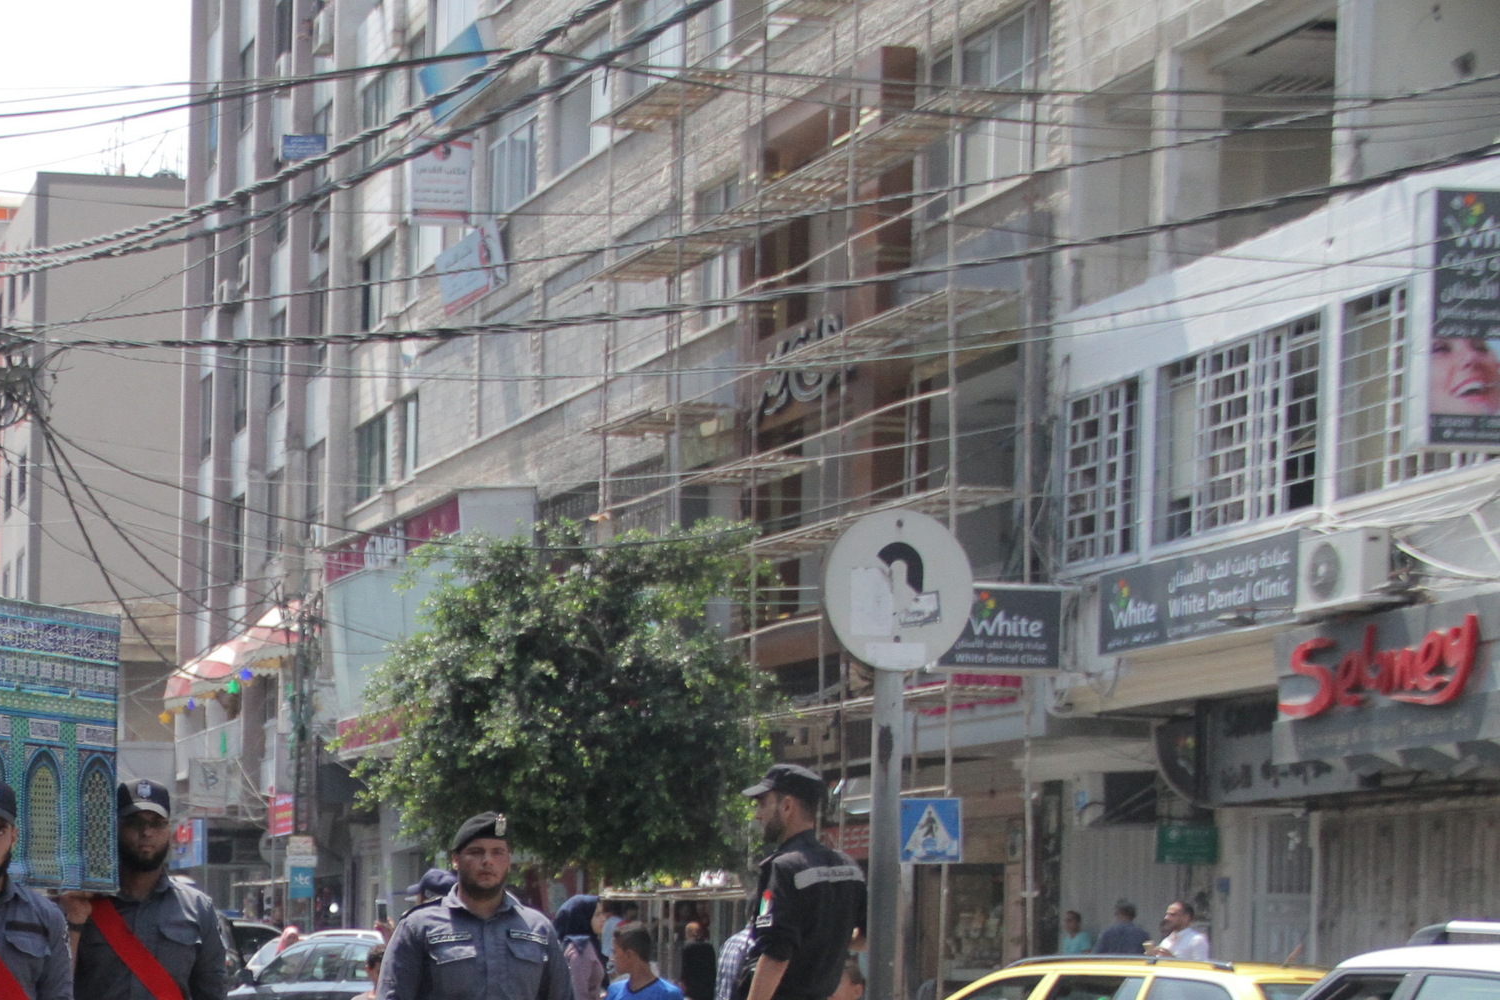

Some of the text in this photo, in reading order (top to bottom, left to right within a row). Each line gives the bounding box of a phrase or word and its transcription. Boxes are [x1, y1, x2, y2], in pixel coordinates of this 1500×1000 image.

[1167, 547, 1291, 594] عيادة وايت لطب الأسنان
[1167, 574, 1291, 618] White Dental Clinic
[969, 610, 1044, 637] White
[1109, 598, 1158, 630] White
[954, 652, 1048, 665] White Dental Clinic
